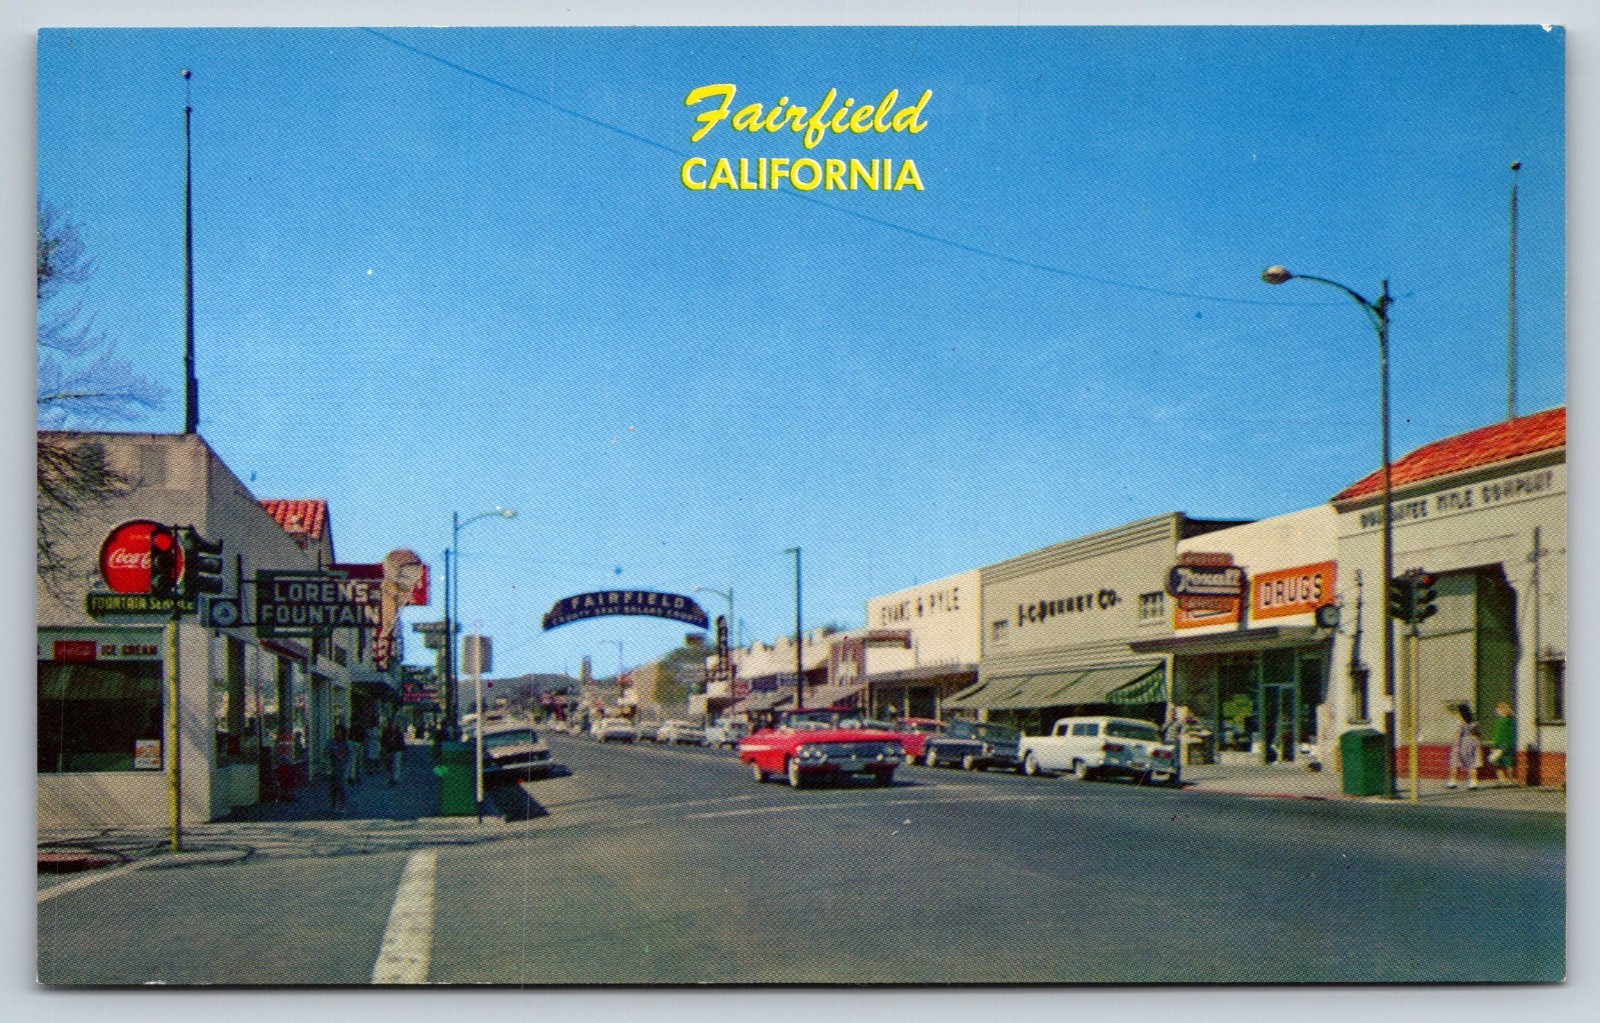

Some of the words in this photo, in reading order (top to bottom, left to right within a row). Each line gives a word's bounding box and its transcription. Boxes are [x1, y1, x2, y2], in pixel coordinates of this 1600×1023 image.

[571, 591, 685, 609] FAIRFIELD
[930, 586, 960, 613] PYLE
[1262, 573, 1324, 608] DRUGS
[261, 604, 380, 624] FOUNTAIN
[101, 644, 117, 656] ICE
[122, 644, 158, 656] CREAM
